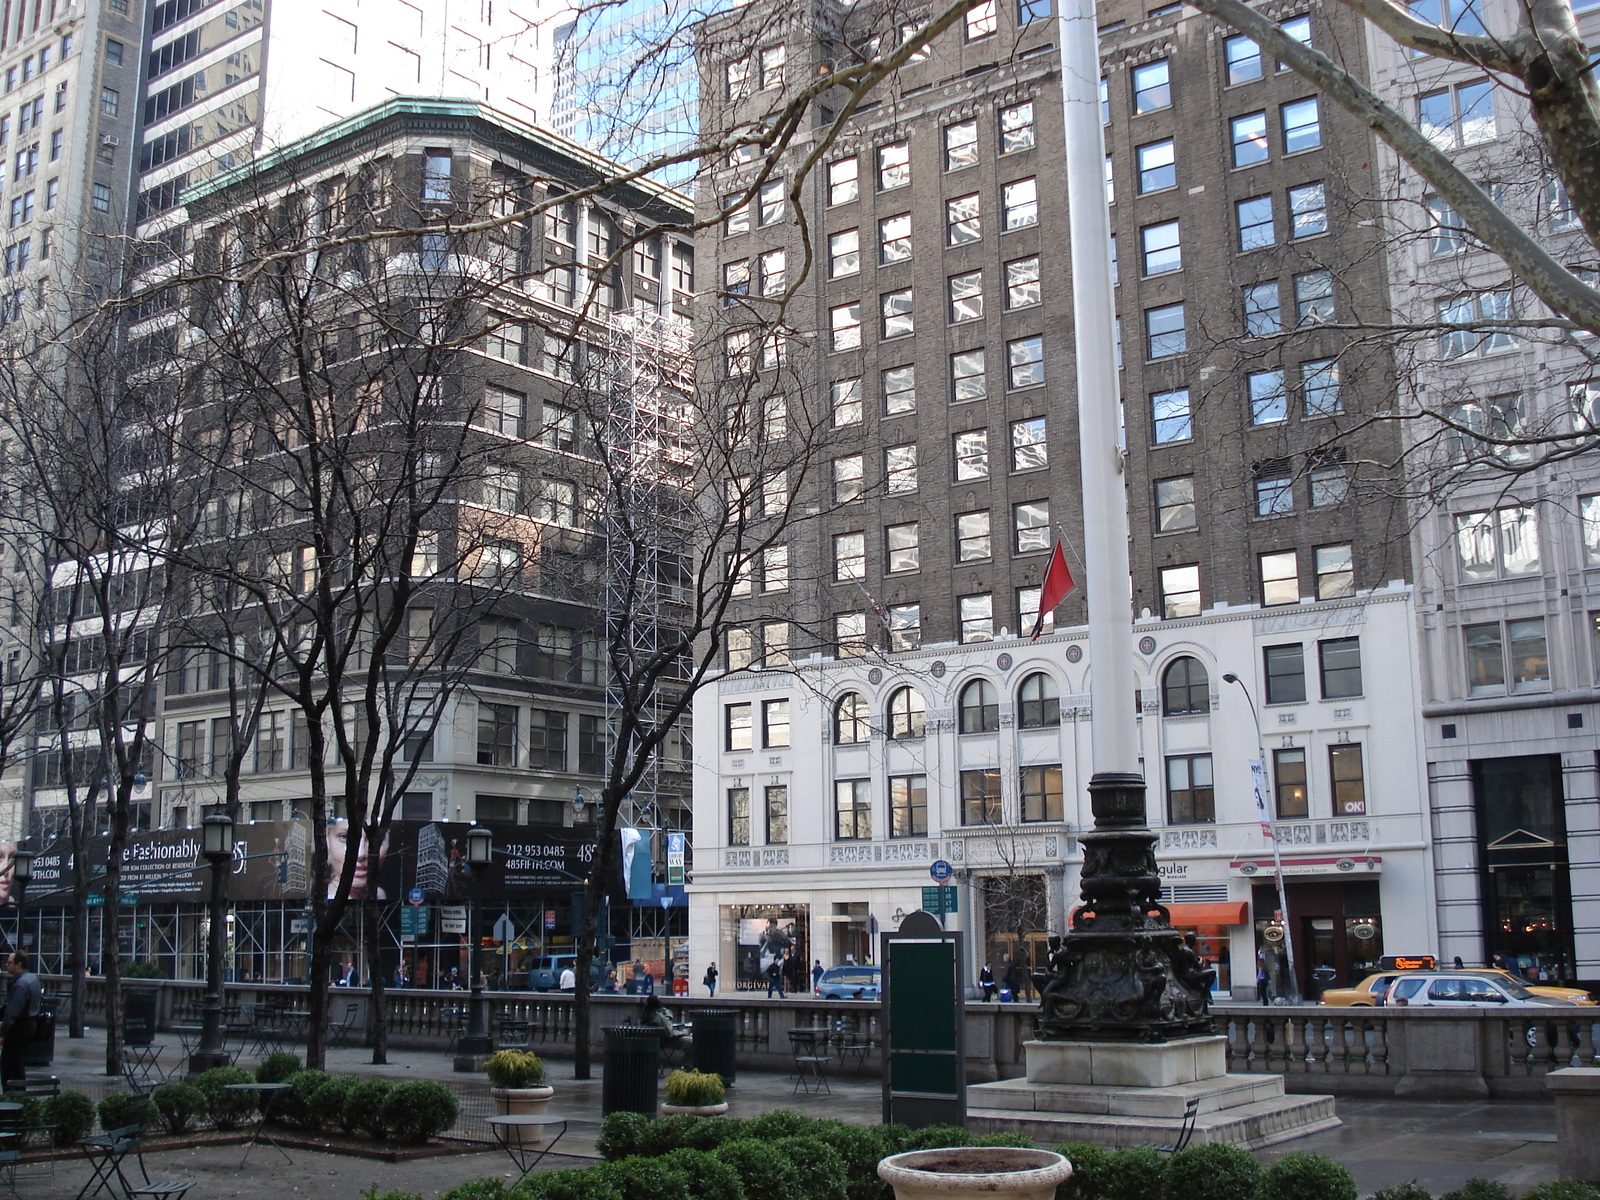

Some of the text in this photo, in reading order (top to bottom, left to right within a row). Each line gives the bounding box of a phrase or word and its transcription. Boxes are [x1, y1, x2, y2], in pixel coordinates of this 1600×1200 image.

[133, 838, 201, 863] Fashionably
[506, 844, 565, 857] 212 953 0485
[33, 855, 60, 868] 953 0485
[140, 863, 165, 871] COLLECTION
[505, 859, 565, 871] 485FIFTH.COM
[669, 858, 682, 866] WAY
[1158, 862, 1188, 878] gular
[127, 873, 139, 881] FROM
